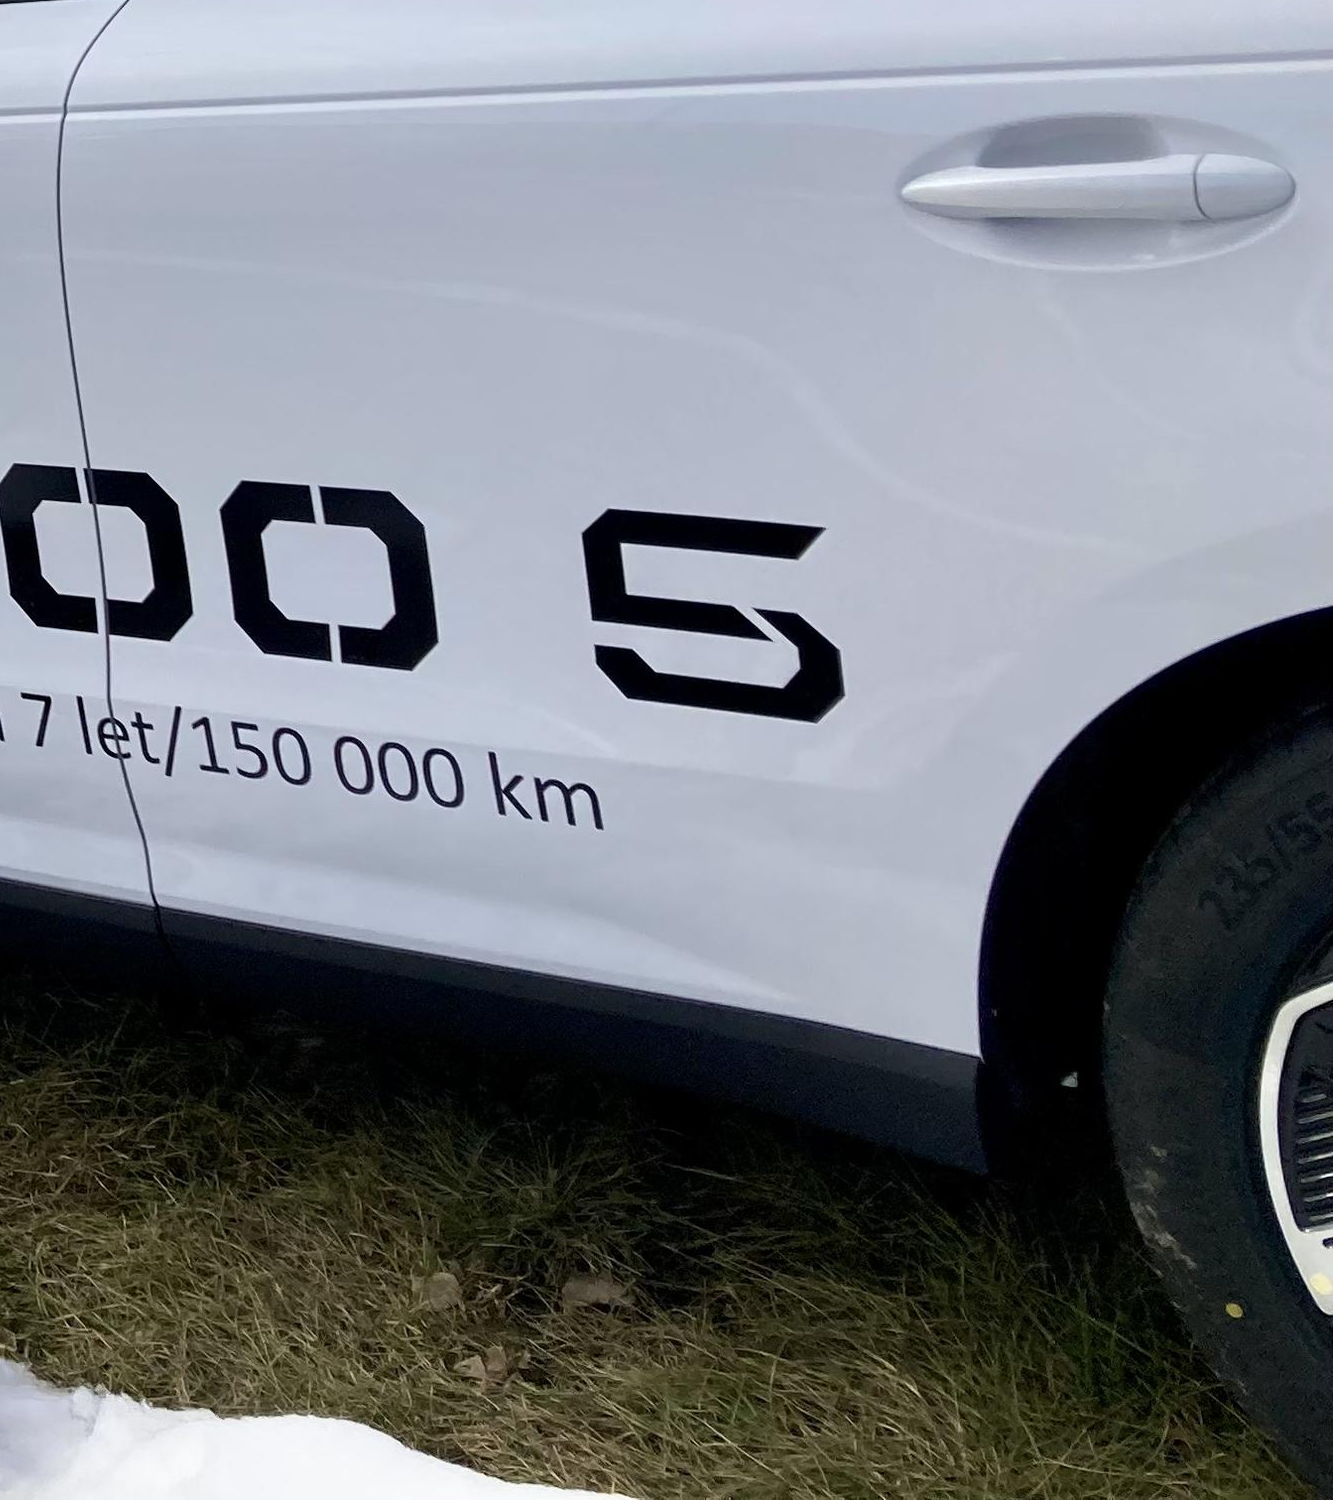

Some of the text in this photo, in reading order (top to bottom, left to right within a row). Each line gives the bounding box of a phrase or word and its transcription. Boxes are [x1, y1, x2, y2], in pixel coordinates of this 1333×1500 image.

[21, 691, 53, 748] 7
[76, 695, 312, 787] let/150
[333, 735, 465, 809] 000
[488, 750, 605, 832] km
